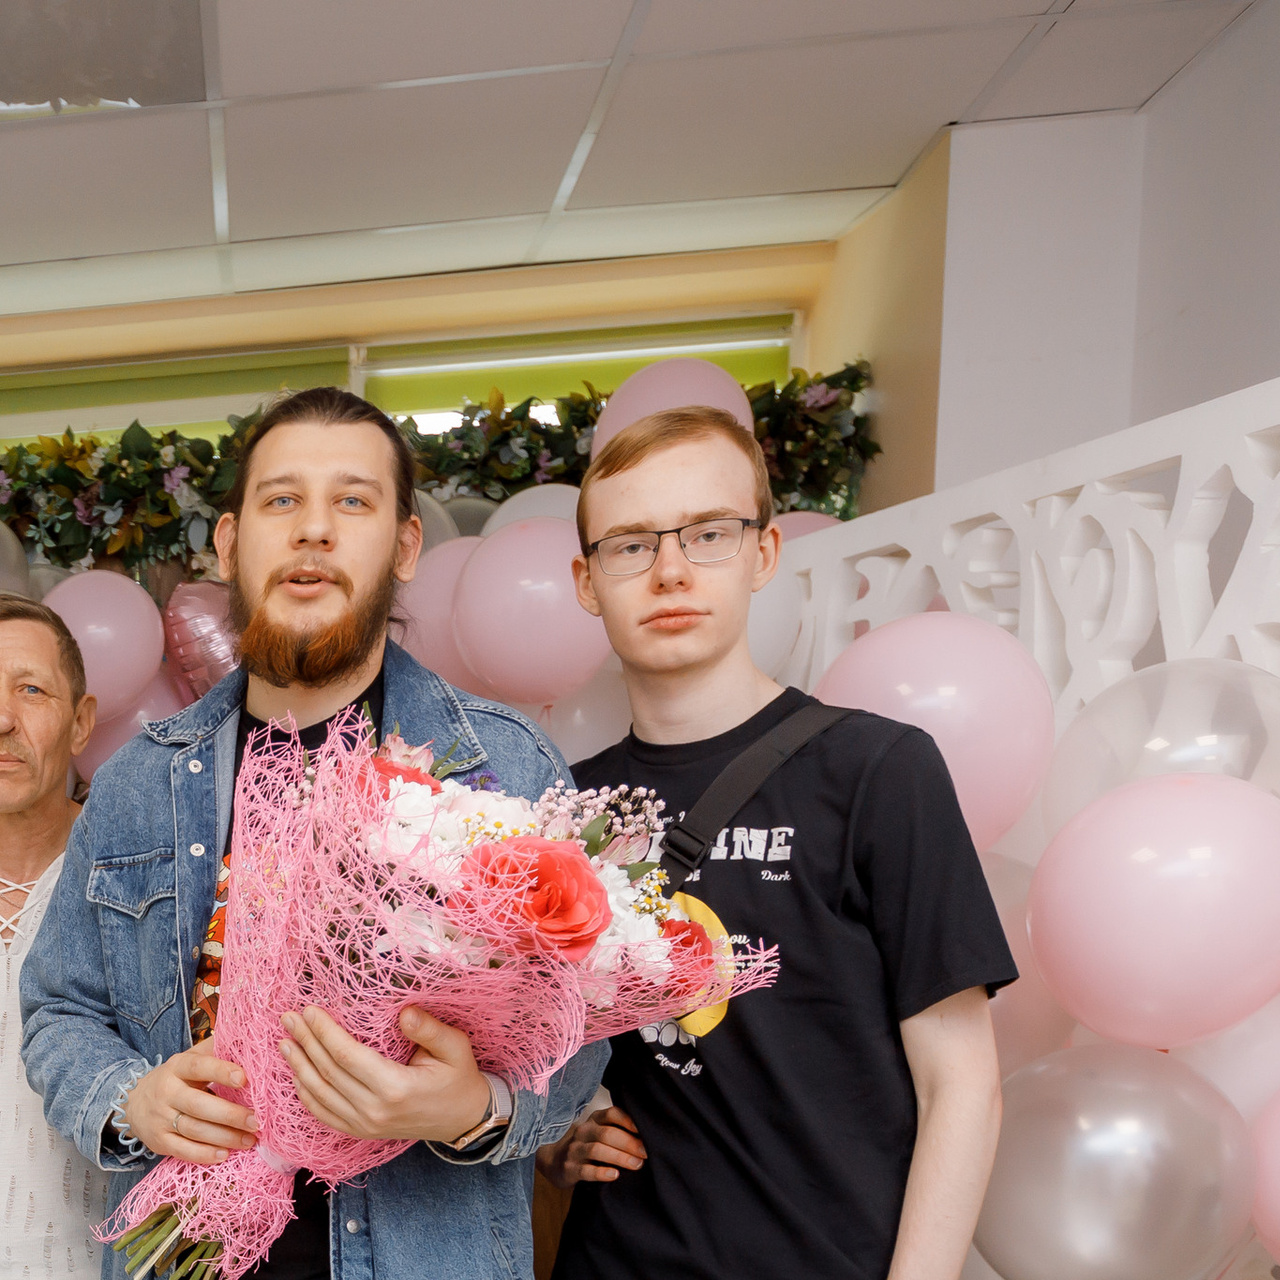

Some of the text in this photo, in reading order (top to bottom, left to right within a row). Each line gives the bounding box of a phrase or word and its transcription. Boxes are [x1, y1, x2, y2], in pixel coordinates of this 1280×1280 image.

[761, 870, 792, 882] Dark
[719, 934, 750, 949] you
[680, 1058, 703, 1077] Joy
